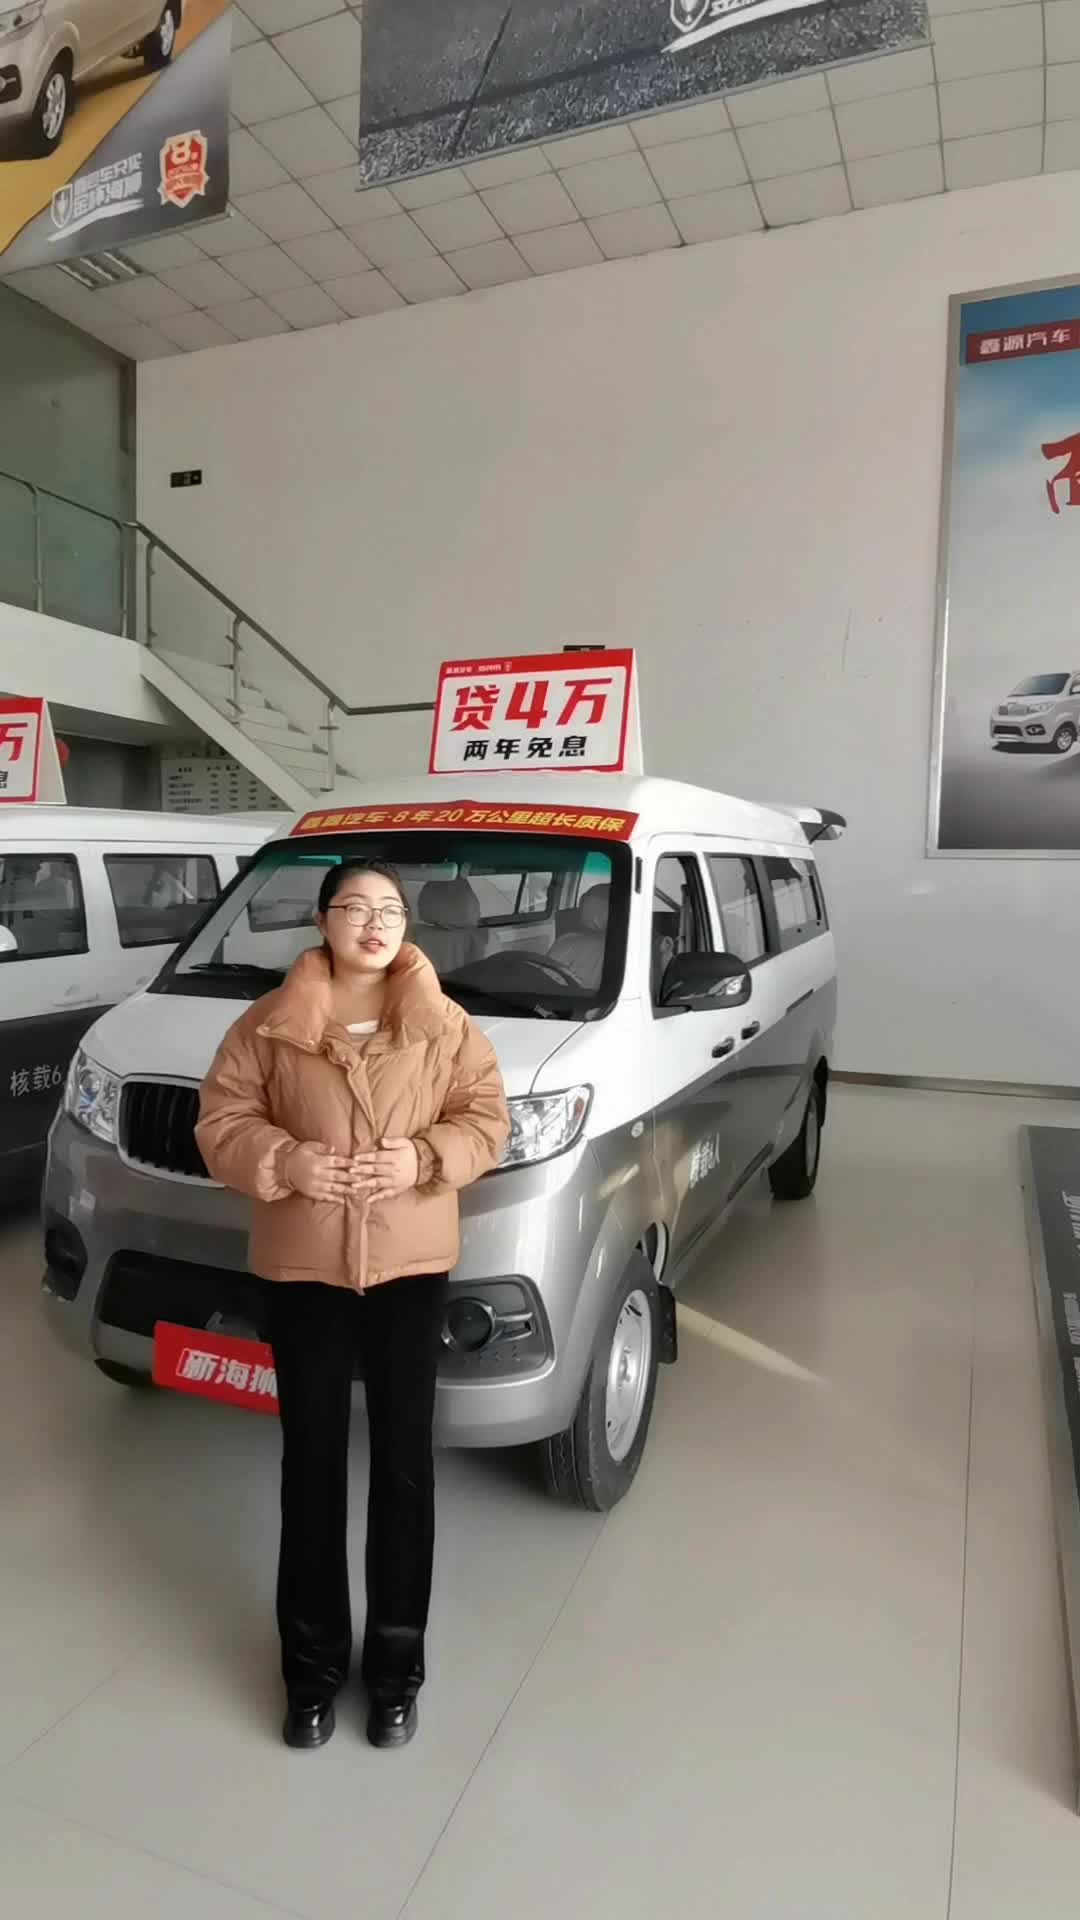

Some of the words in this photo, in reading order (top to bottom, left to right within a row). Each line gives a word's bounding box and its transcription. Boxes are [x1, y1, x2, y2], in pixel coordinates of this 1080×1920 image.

[980, 328, 1071, 355] 鑫源汽车
[449, 677, 613, 732] 贷4万
[464, 735, 588, 761] 两年免息
